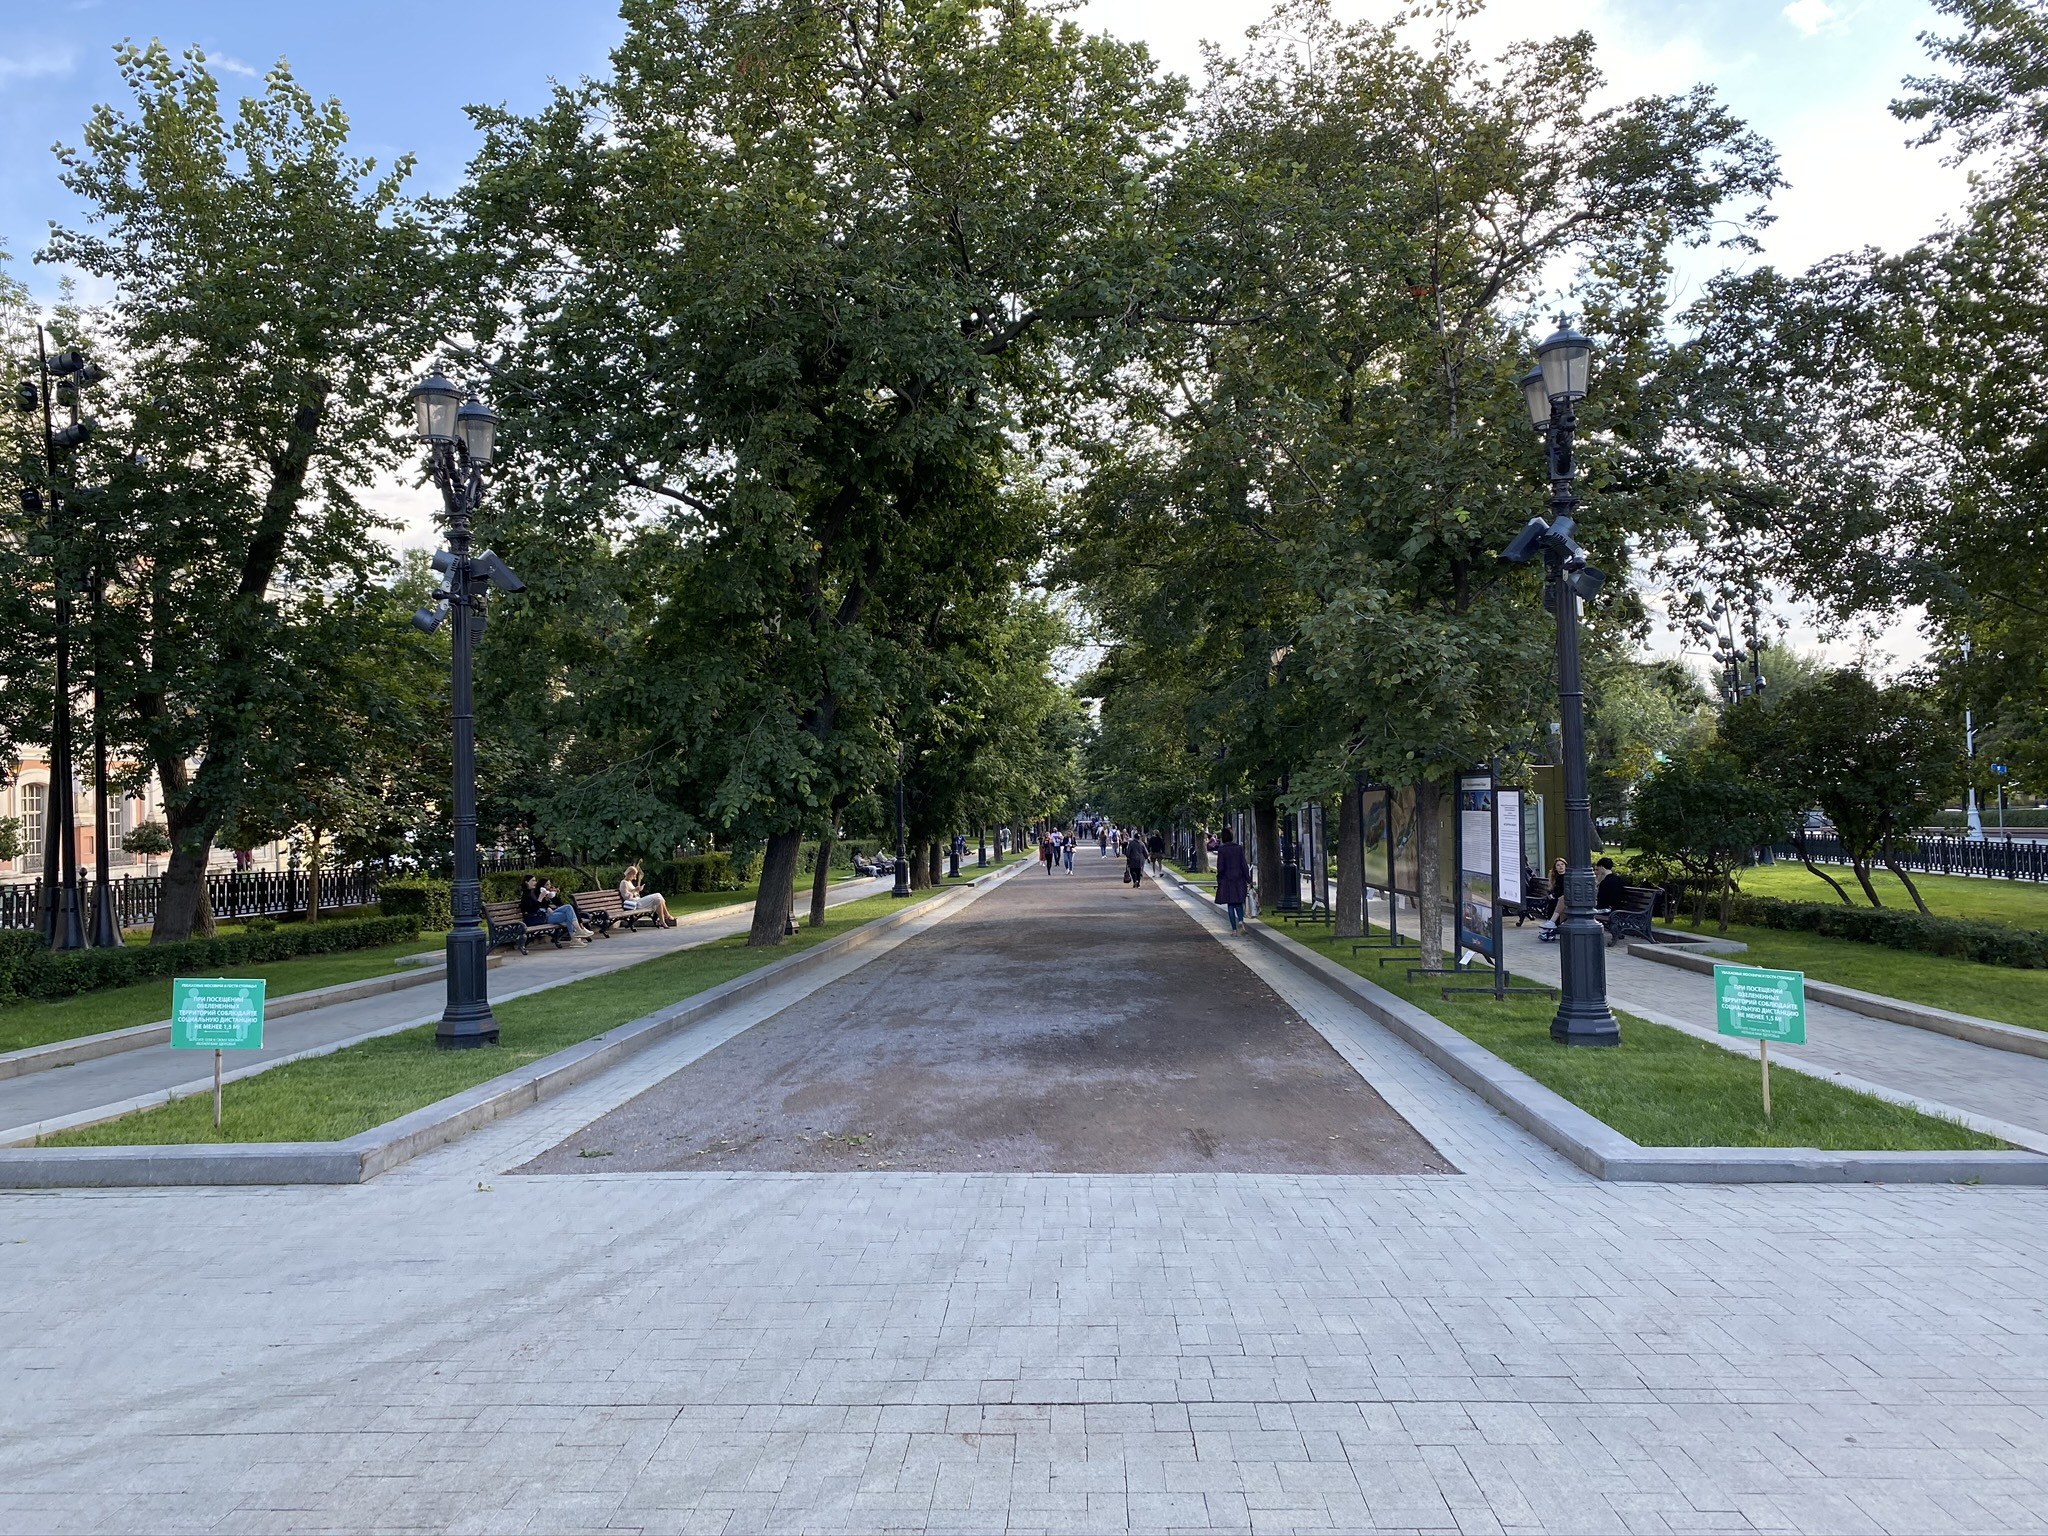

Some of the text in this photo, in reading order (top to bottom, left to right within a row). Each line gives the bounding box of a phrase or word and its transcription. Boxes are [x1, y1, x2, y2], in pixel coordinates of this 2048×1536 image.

[1746, 985, 1783, 994] ПОСЕЩЕНИИ
[1721, 996, 1798, 1010] ТЕРРИТОРИЙ СОБЛЮДАЙТЕ
[1721, 1003, 1799, 1017] СОЦИАЛЬНУЮ ДИСТАНЦИЮ
[1746, 1012, 1765, 1020] МЕНЕЕ
[223, 1023, 232, 1031] 1,5
